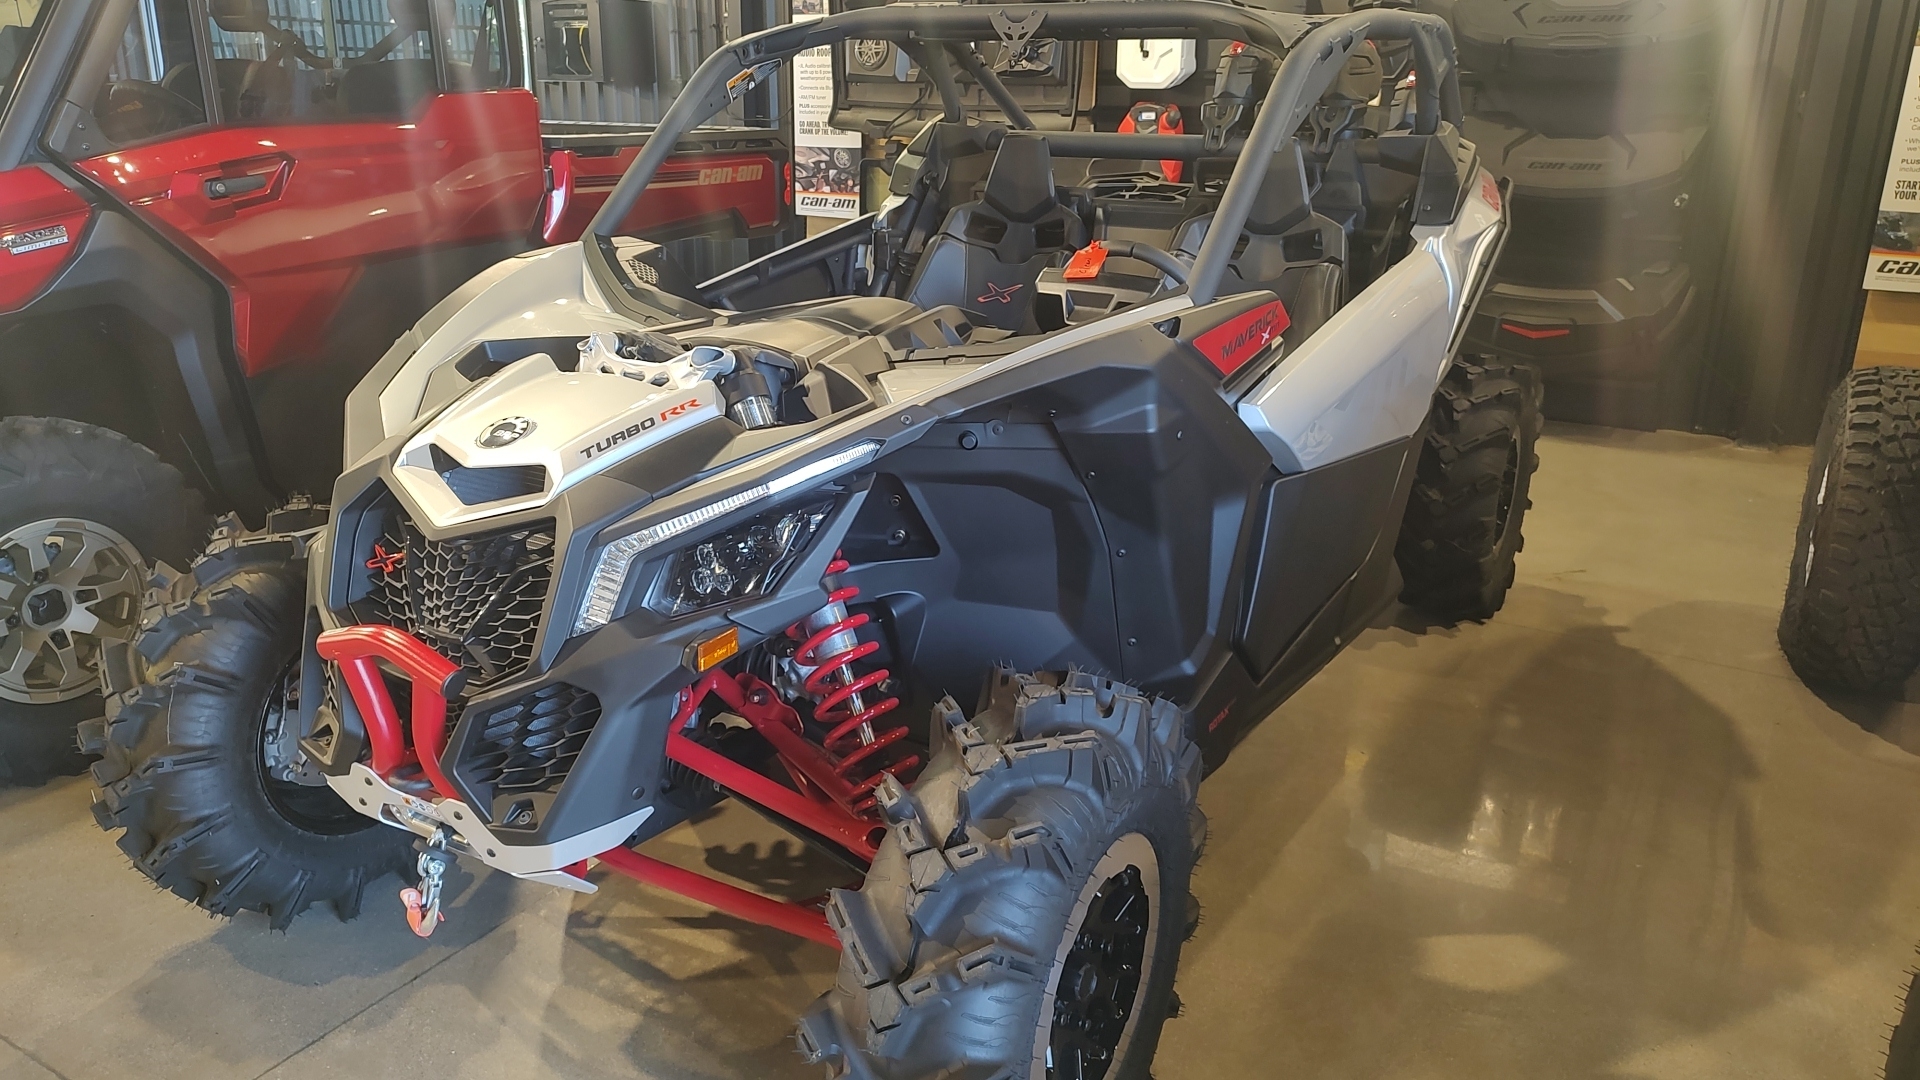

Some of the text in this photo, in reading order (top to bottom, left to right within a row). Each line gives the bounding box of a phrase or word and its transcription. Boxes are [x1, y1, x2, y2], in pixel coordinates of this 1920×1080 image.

[821, 128, 830, 136] THE
[1527, 161, 1602, 171] can-am
[699, 164, 764, 186] can-am
[1894, 190, 1918, 201] YOUR
[800, 196, 857, 209] can-am
[1222, 304, 1280, 360] MAVERICK
[580, 398, 703, 459] TURBO RR
